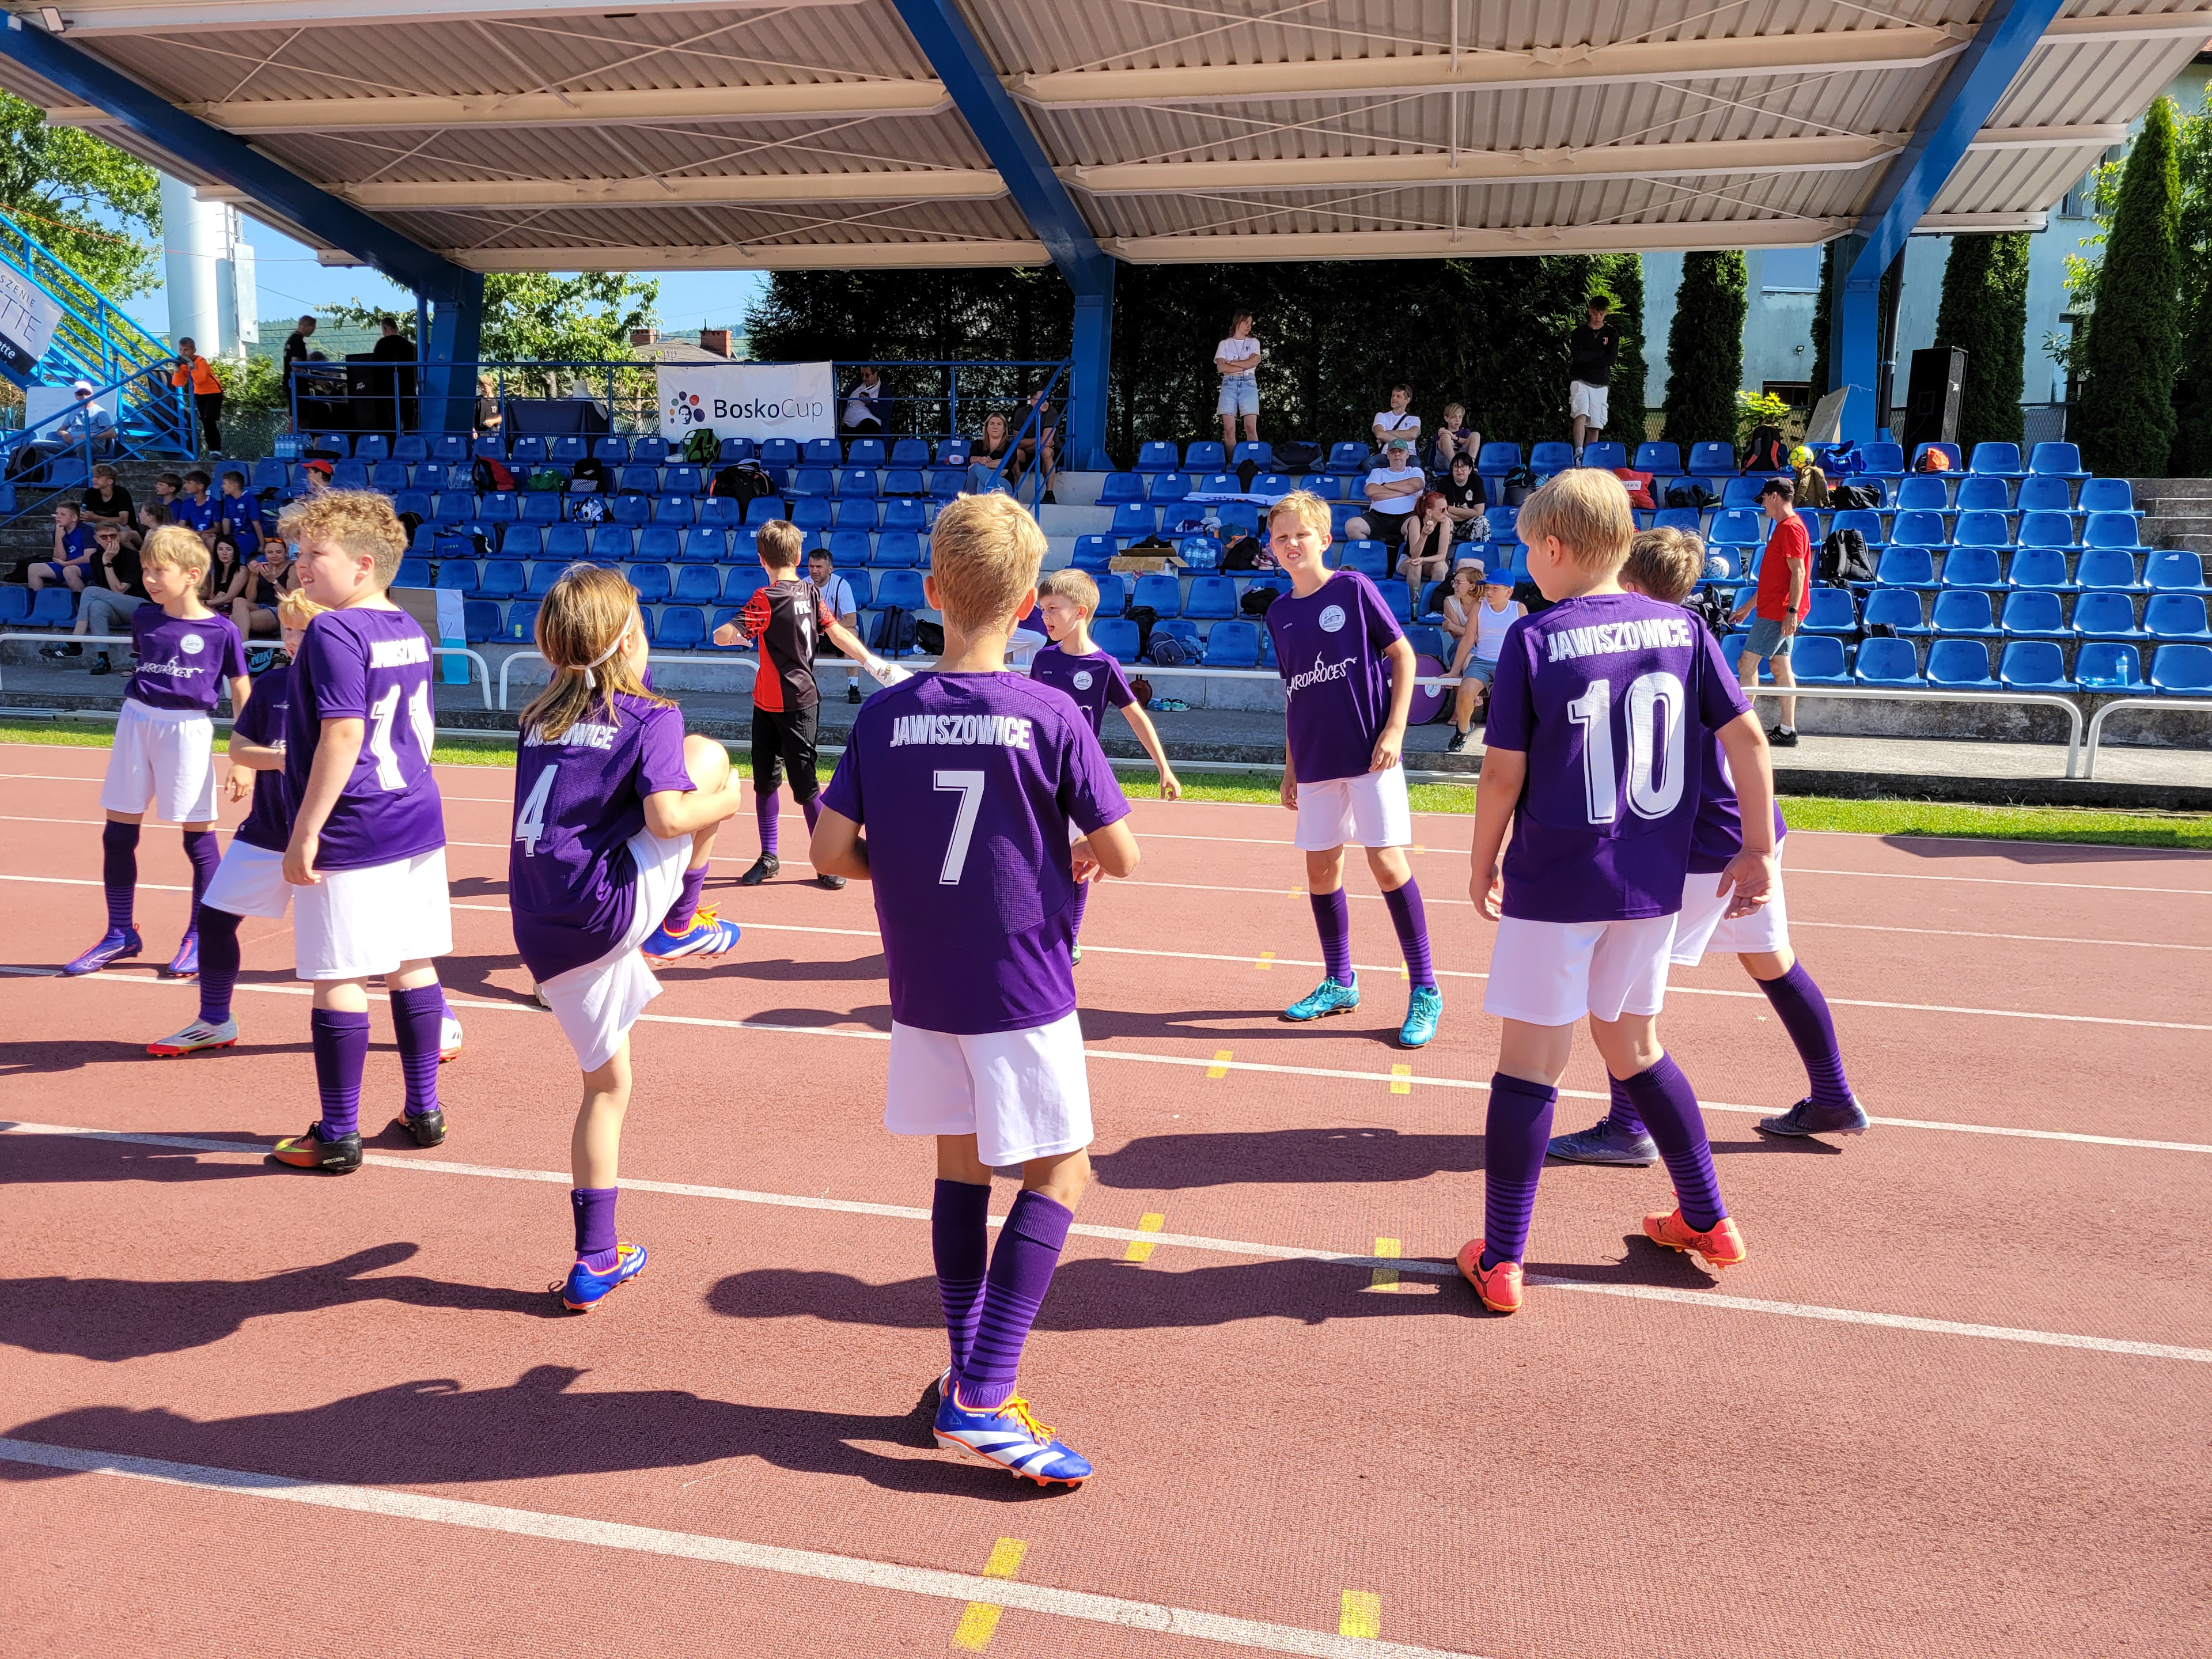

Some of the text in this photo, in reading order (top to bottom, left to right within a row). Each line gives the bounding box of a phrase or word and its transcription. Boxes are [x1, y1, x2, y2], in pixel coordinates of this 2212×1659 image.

[0, 290, 41, 342] TTE
[714, 398, 823, 423] BoskoCup
[1548, 619, 1692, 663] JAWISZOWICE
[370, 680, 435, 791] 11
[890, 714, 1032, 750] JAWISZOWICE
[1567, 672, 1685, 825] 10
[515, 764, 559, 857] 4
[933, 770, 985, 885] 7
